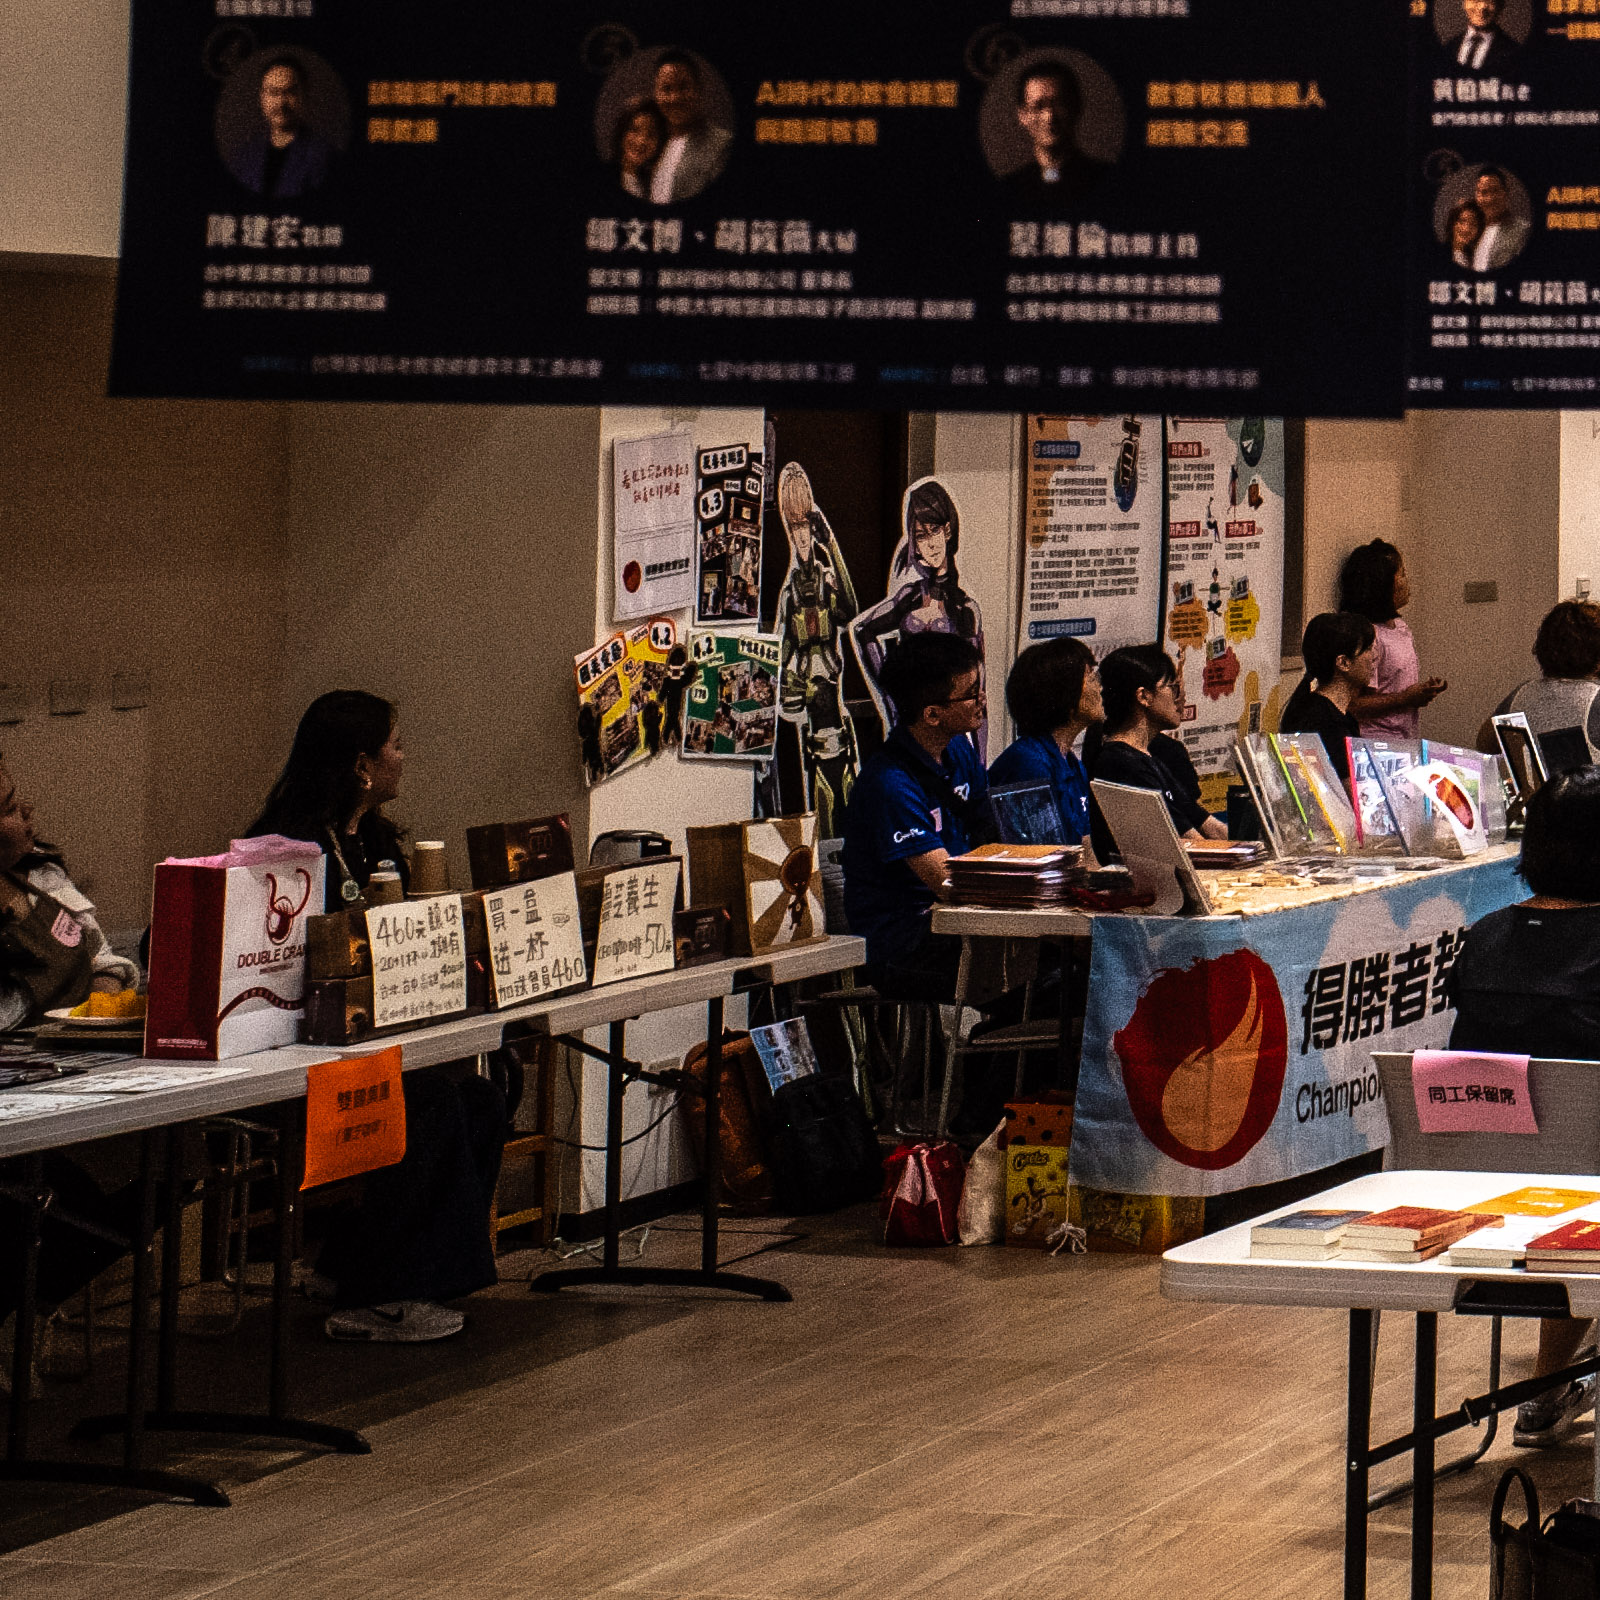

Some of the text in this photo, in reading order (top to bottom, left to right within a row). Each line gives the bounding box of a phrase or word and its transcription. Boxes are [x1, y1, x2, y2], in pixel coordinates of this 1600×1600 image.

[236, 949, 282, 969] DOUBLE
[1295, 1066, 1382, 1123] Champio
[1428, 1084, 1517, 1106] 同工保留席
